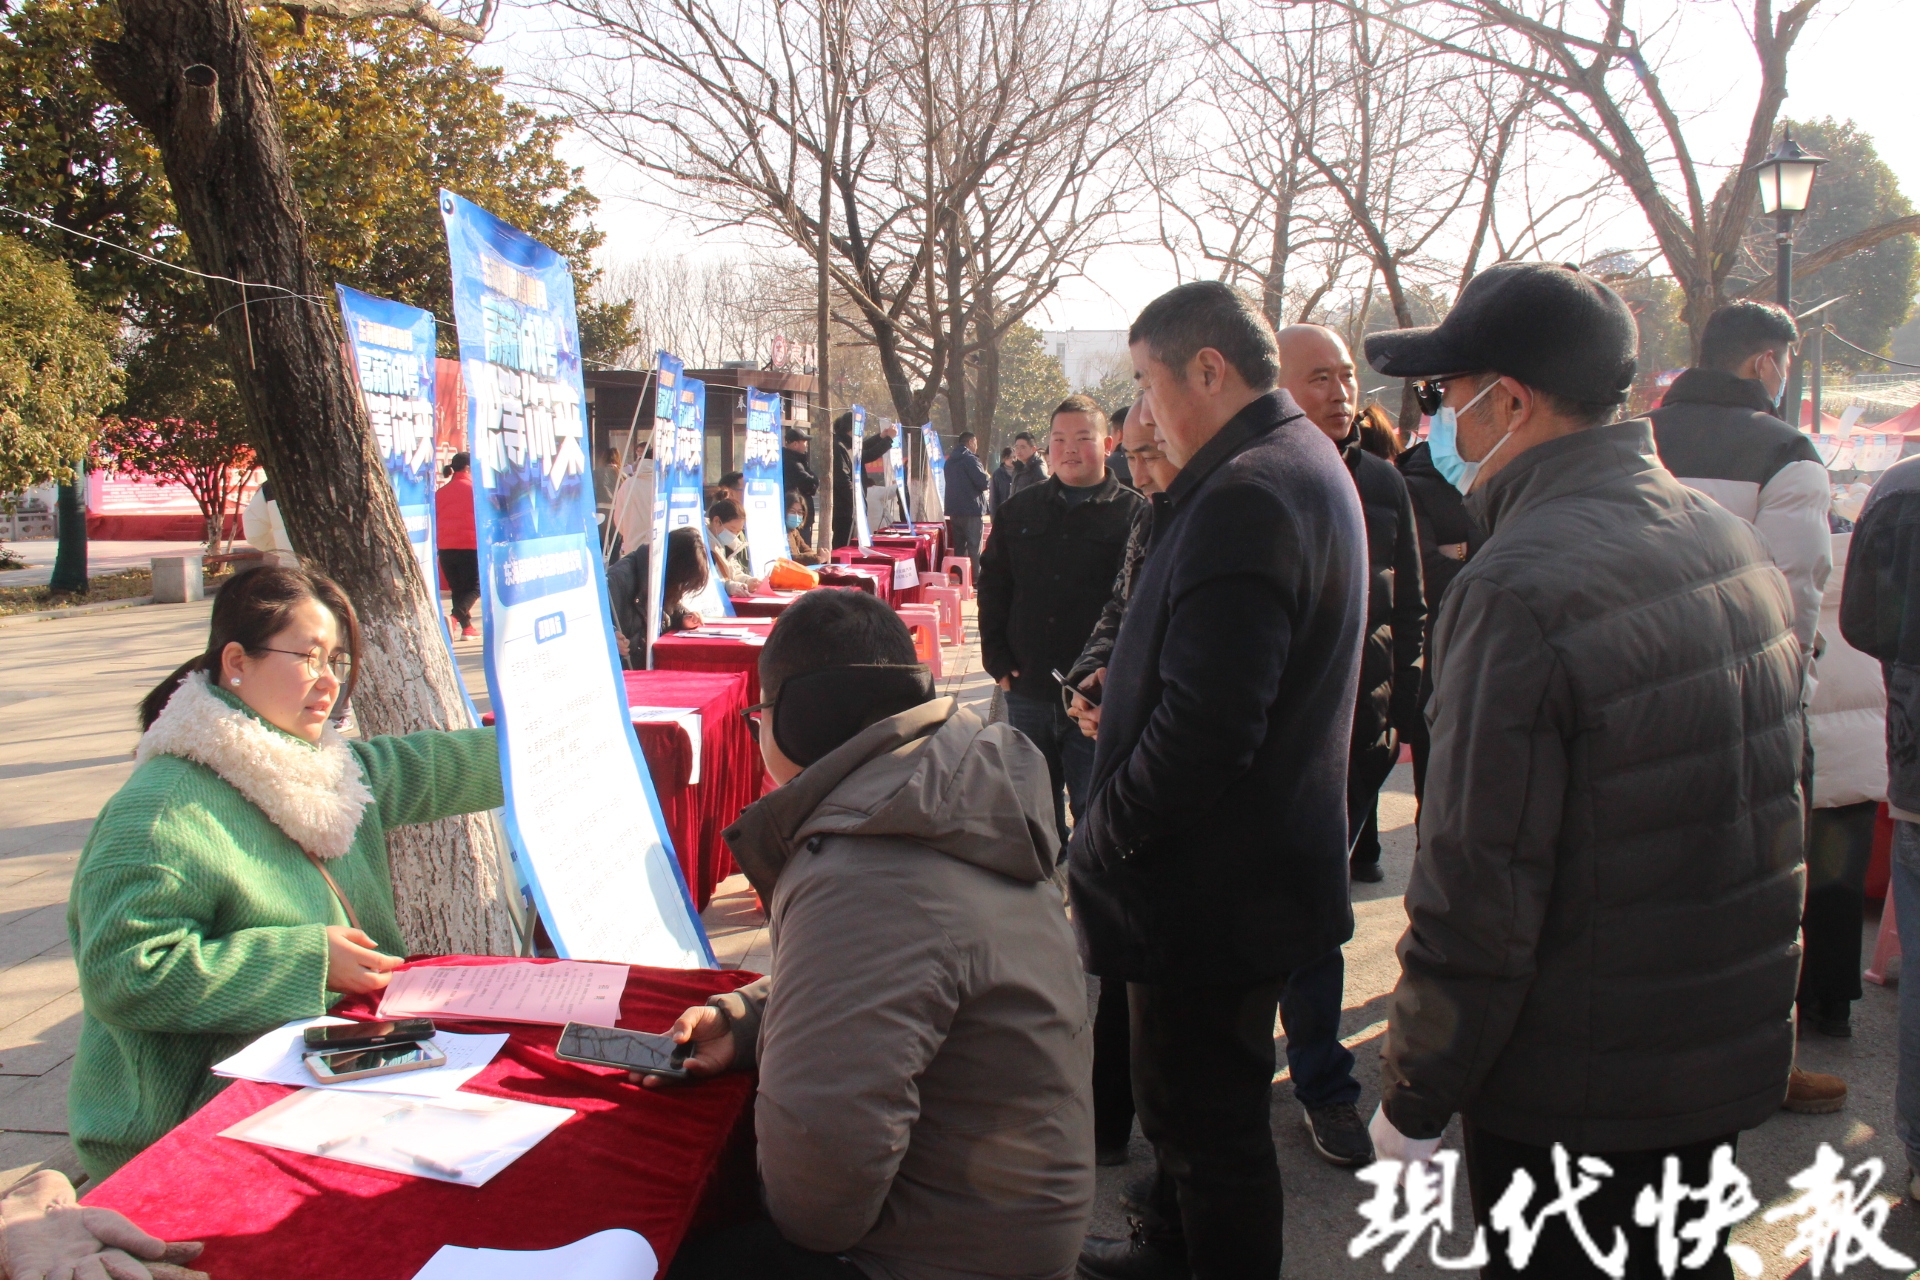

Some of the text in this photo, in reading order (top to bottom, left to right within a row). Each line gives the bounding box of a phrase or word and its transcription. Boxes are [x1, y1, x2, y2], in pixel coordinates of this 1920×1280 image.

[357, 346, 420, 397] 高薪诚聘
[480, 295, 558, 377] 高薪诚聘
[366, 393, 434, 474] 等你来
[468, 358, 586, 492] 职等你来
